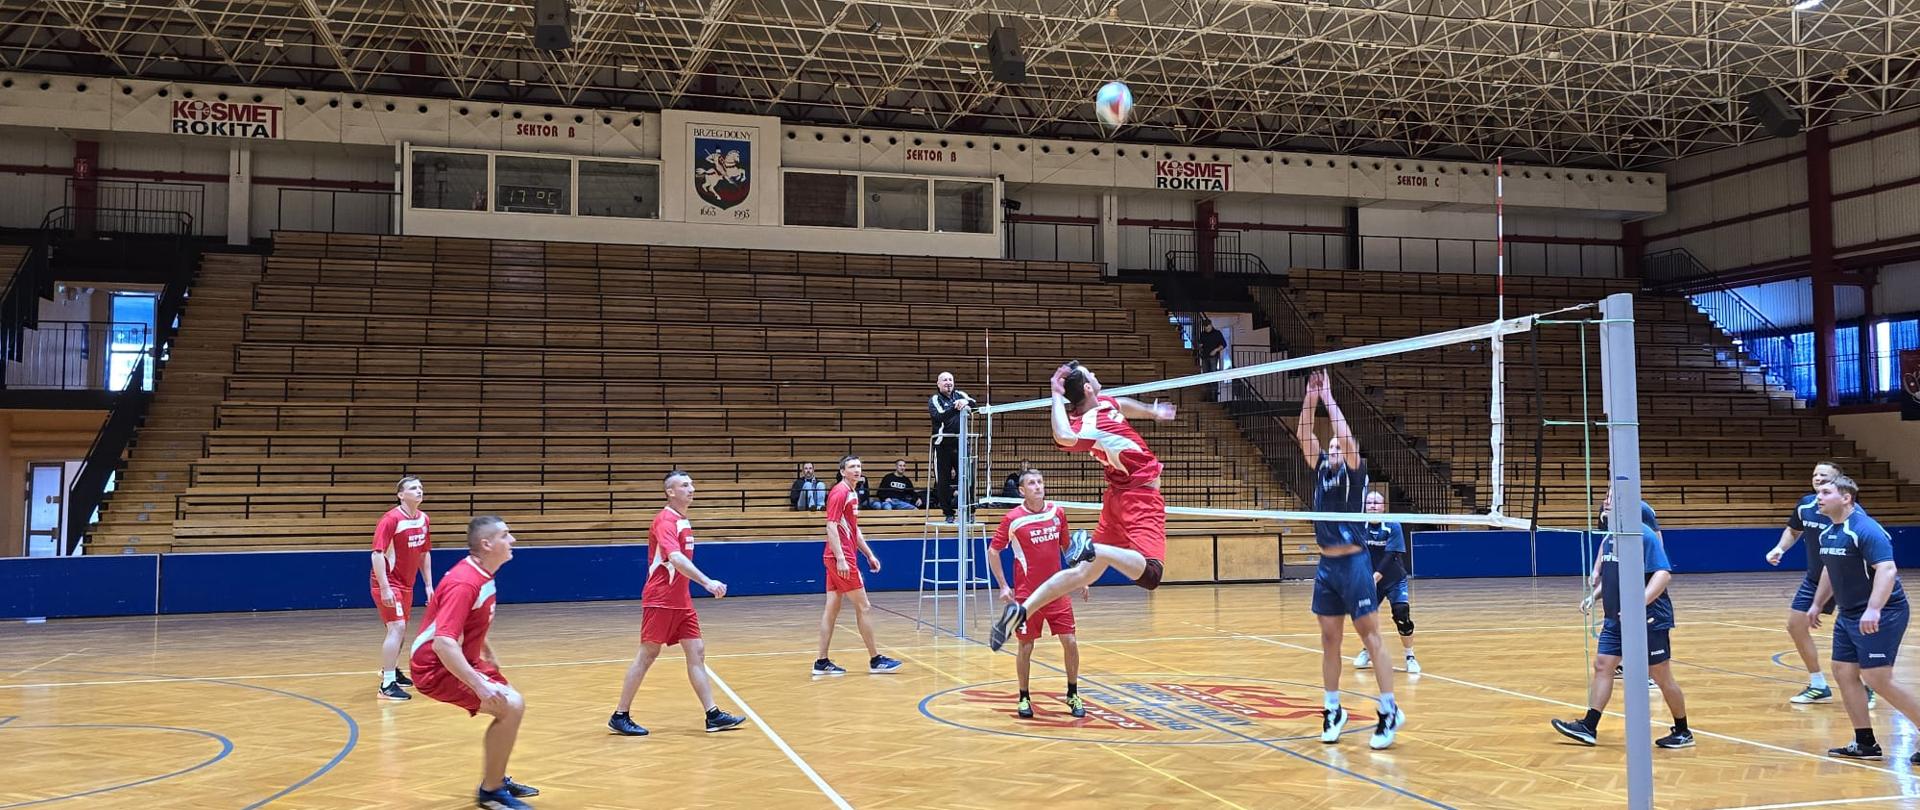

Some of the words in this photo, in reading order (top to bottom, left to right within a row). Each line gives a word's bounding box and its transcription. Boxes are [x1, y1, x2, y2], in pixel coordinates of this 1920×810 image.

[173, 99, 283, 138] KOSMET
[172, 119, 270, 138] ROKITA
[516, 123, 559, 137] SEKTOR
[568, 126, 576, 138] B
[693, 128, 722, 138] BRZEG
[724, 130, 752, 140] DOLNY
[906, 149, 943, 162] SEKTOR
[950, 151, 957, 162] B
[1156, 160, 1232, 191] KOSMET
[1397, 175, 1428, 187] SEKTOR
[1434, 177, 1440, 188] C
[1156, 176, 1224, 191] ROKITA
[510, 189, 526, 203] 17
[1159, 684, 1259, 715] ROKITA
